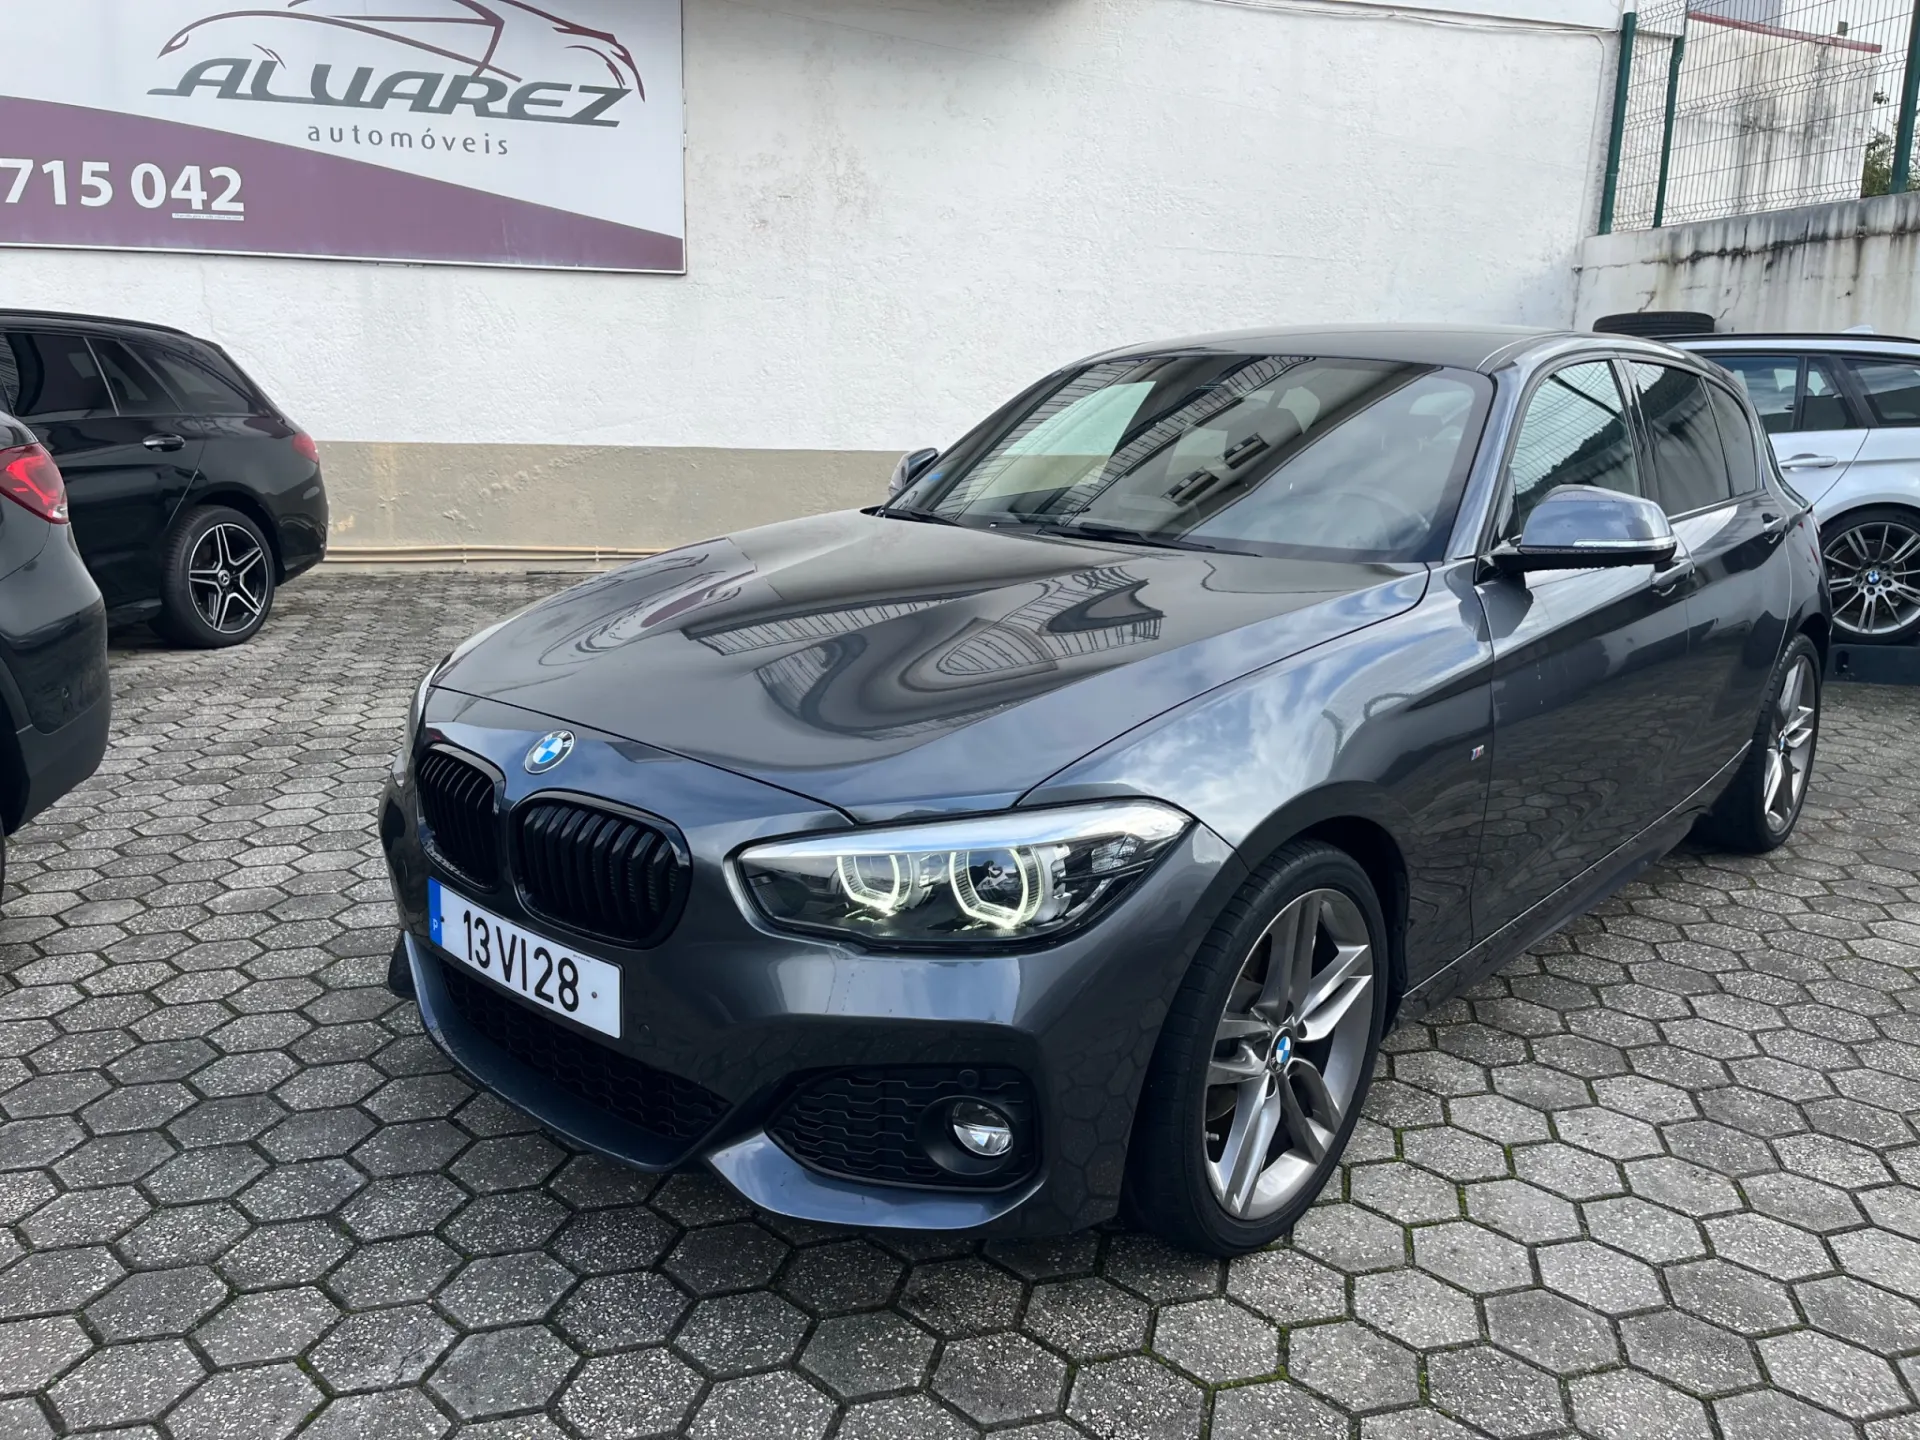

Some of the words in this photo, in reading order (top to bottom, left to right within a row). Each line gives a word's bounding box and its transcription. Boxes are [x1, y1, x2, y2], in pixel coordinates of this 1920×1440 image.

[146, 57, 633, 128] ALVAREZ
[307, 123, 509, 156] automóveis
[0, 157, 113, 207] 715
[130, 162, 245, 212] 042
[432, 918, 439, 931] P
